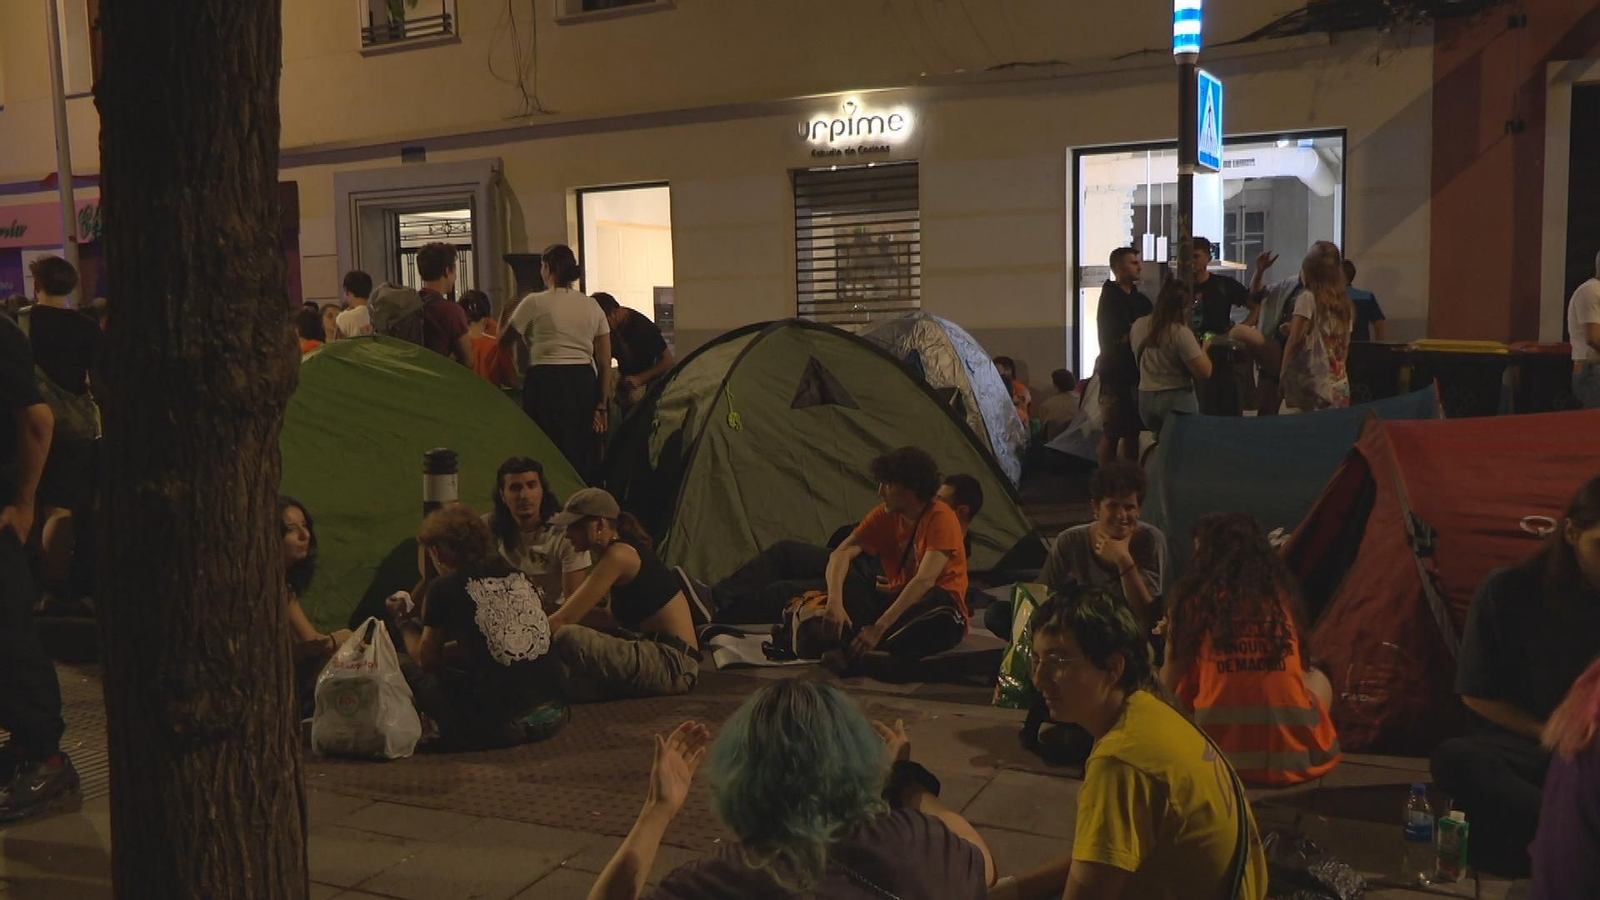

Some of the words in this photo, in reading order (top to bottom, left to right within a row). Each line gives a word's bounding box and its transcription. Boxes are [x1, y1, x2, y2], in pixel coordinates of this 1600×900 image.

[797, 112, 904, 141] urpime
[811, 147, 842, 157] Estudio
[845, 146, 856, 155] de
[858, 145, 891, 154] Cocinas
[1216, 659, 1233, 673] DE
[1236, 657, 1286, 671] MADID
